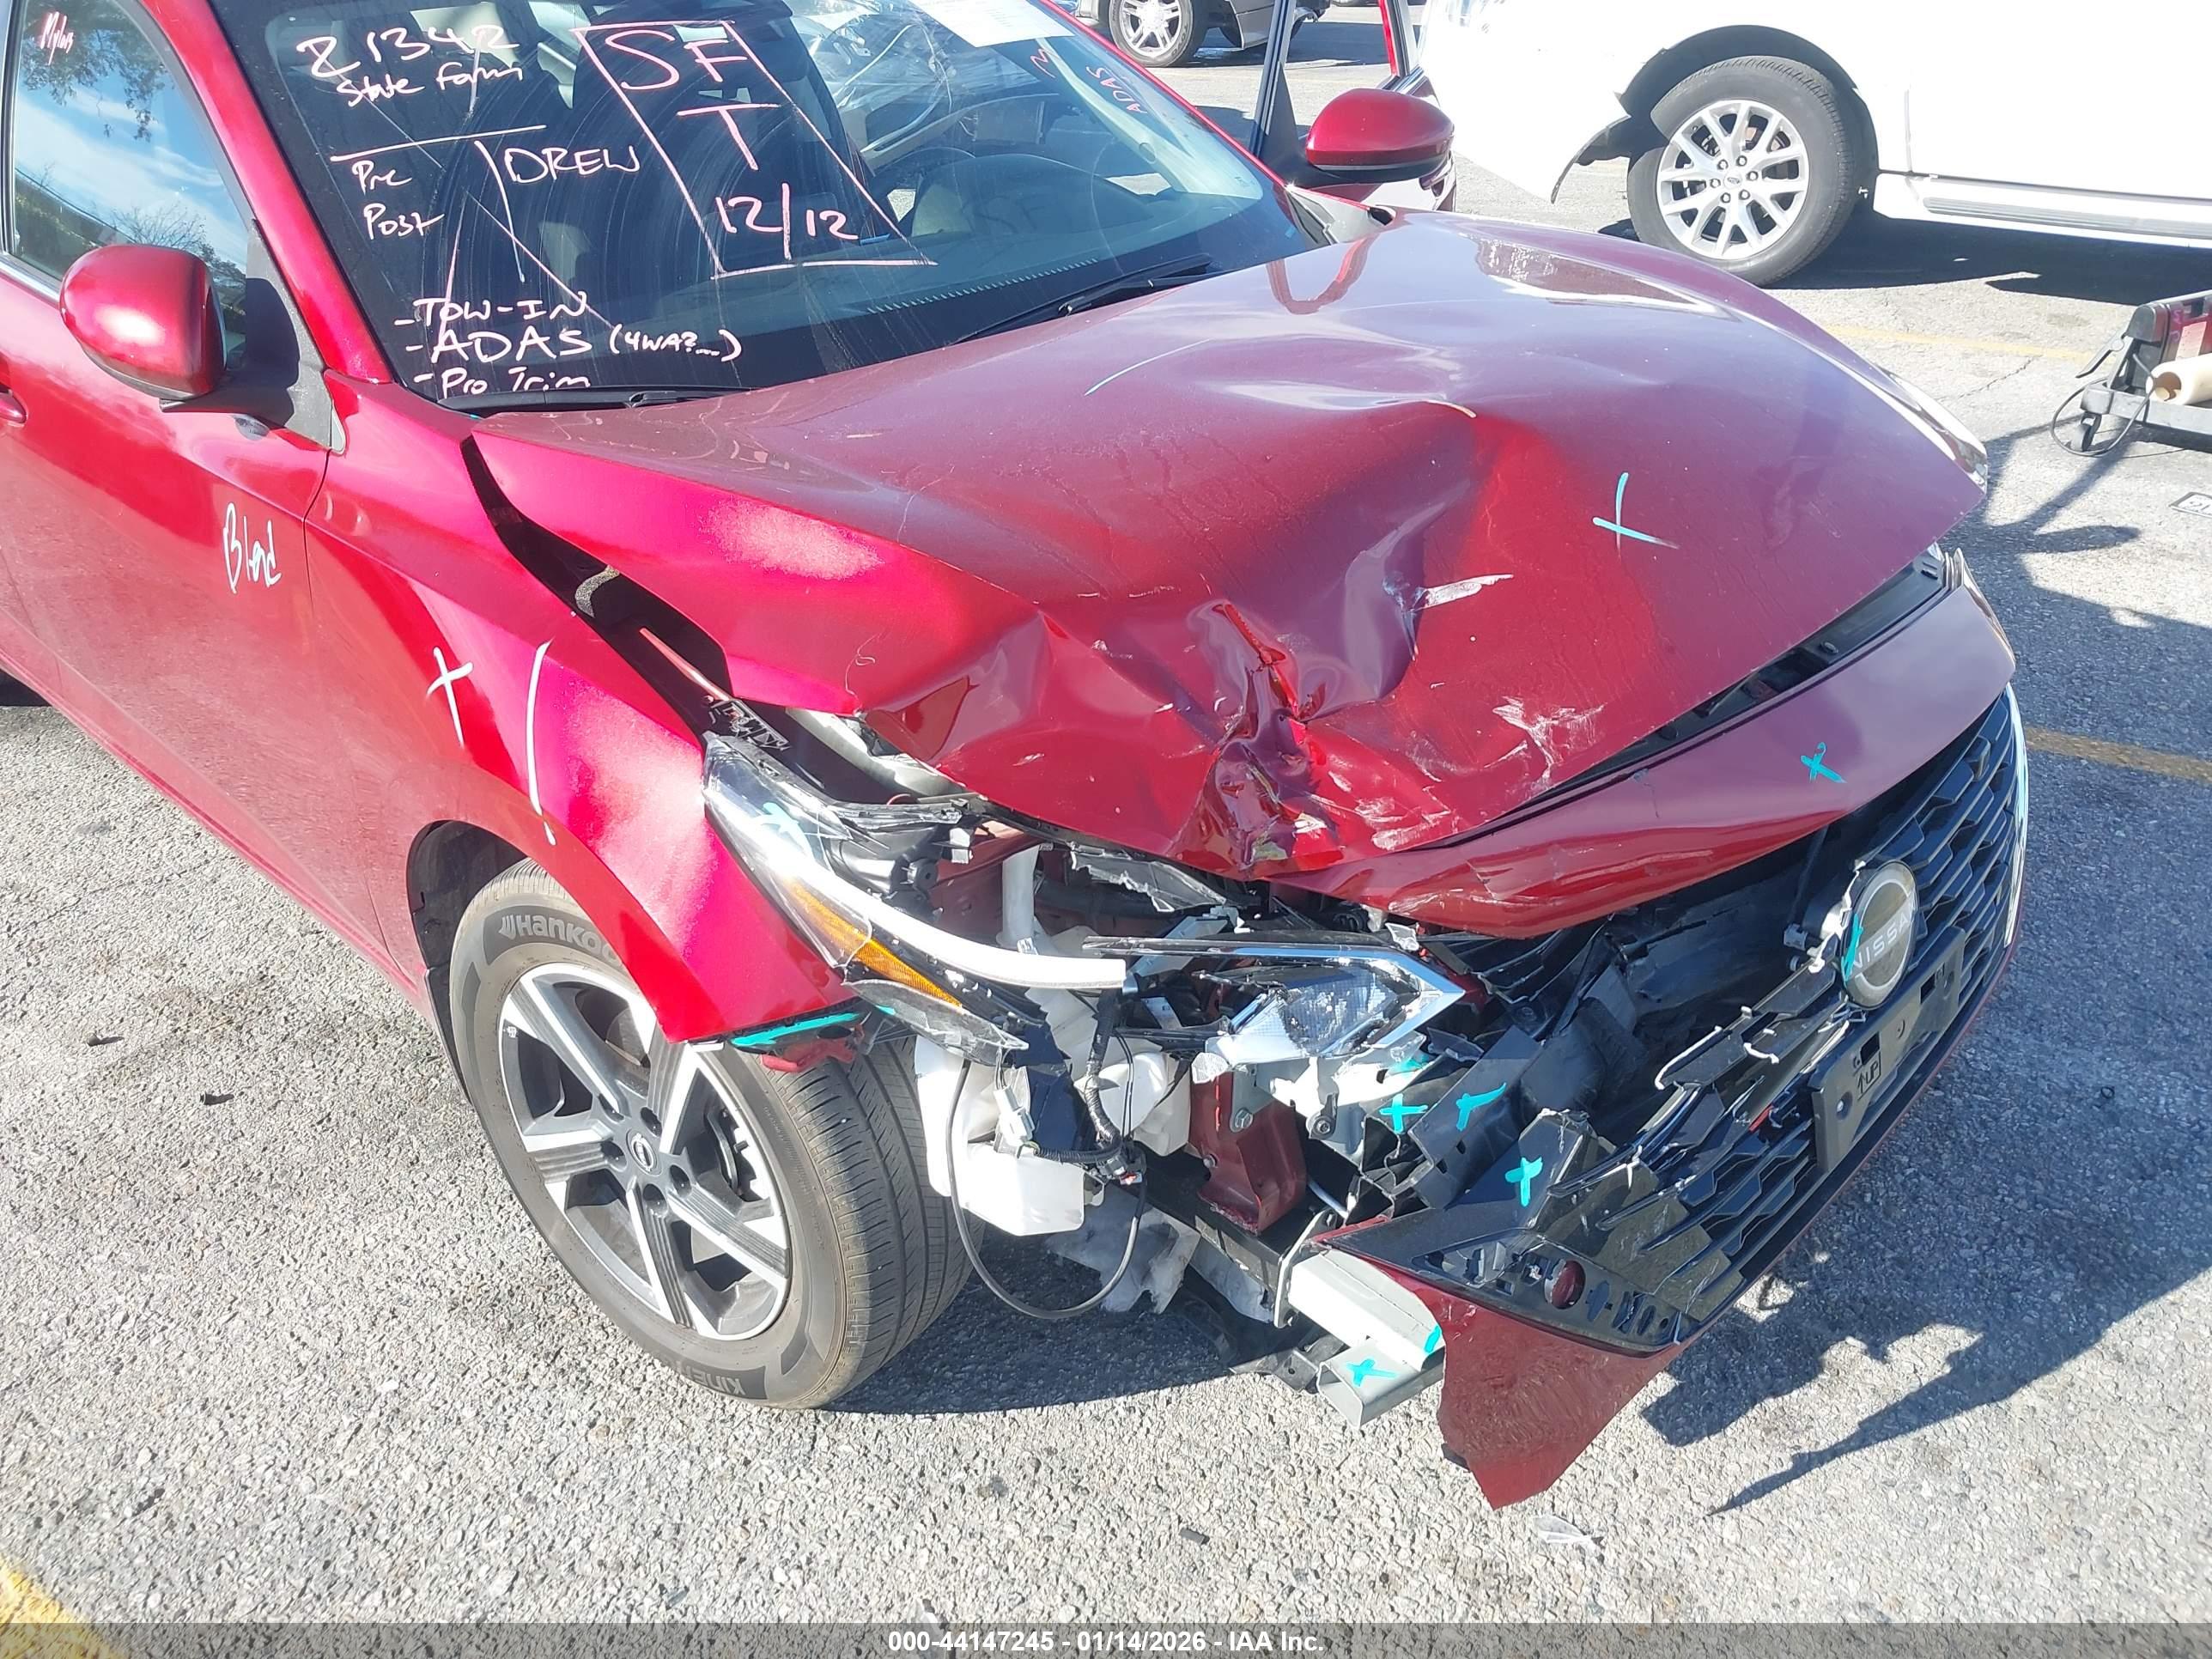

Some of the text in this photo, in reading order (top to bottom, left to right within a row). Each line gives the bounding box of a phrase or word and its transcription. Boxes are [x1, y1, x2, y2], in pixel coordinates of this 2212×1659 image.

[1085, 65, 1148, 114] ADAS
[504, 146, 641, 184] DREW
[677, 102, 782, 171] T
[715, 182, 859, 260] 12/12
